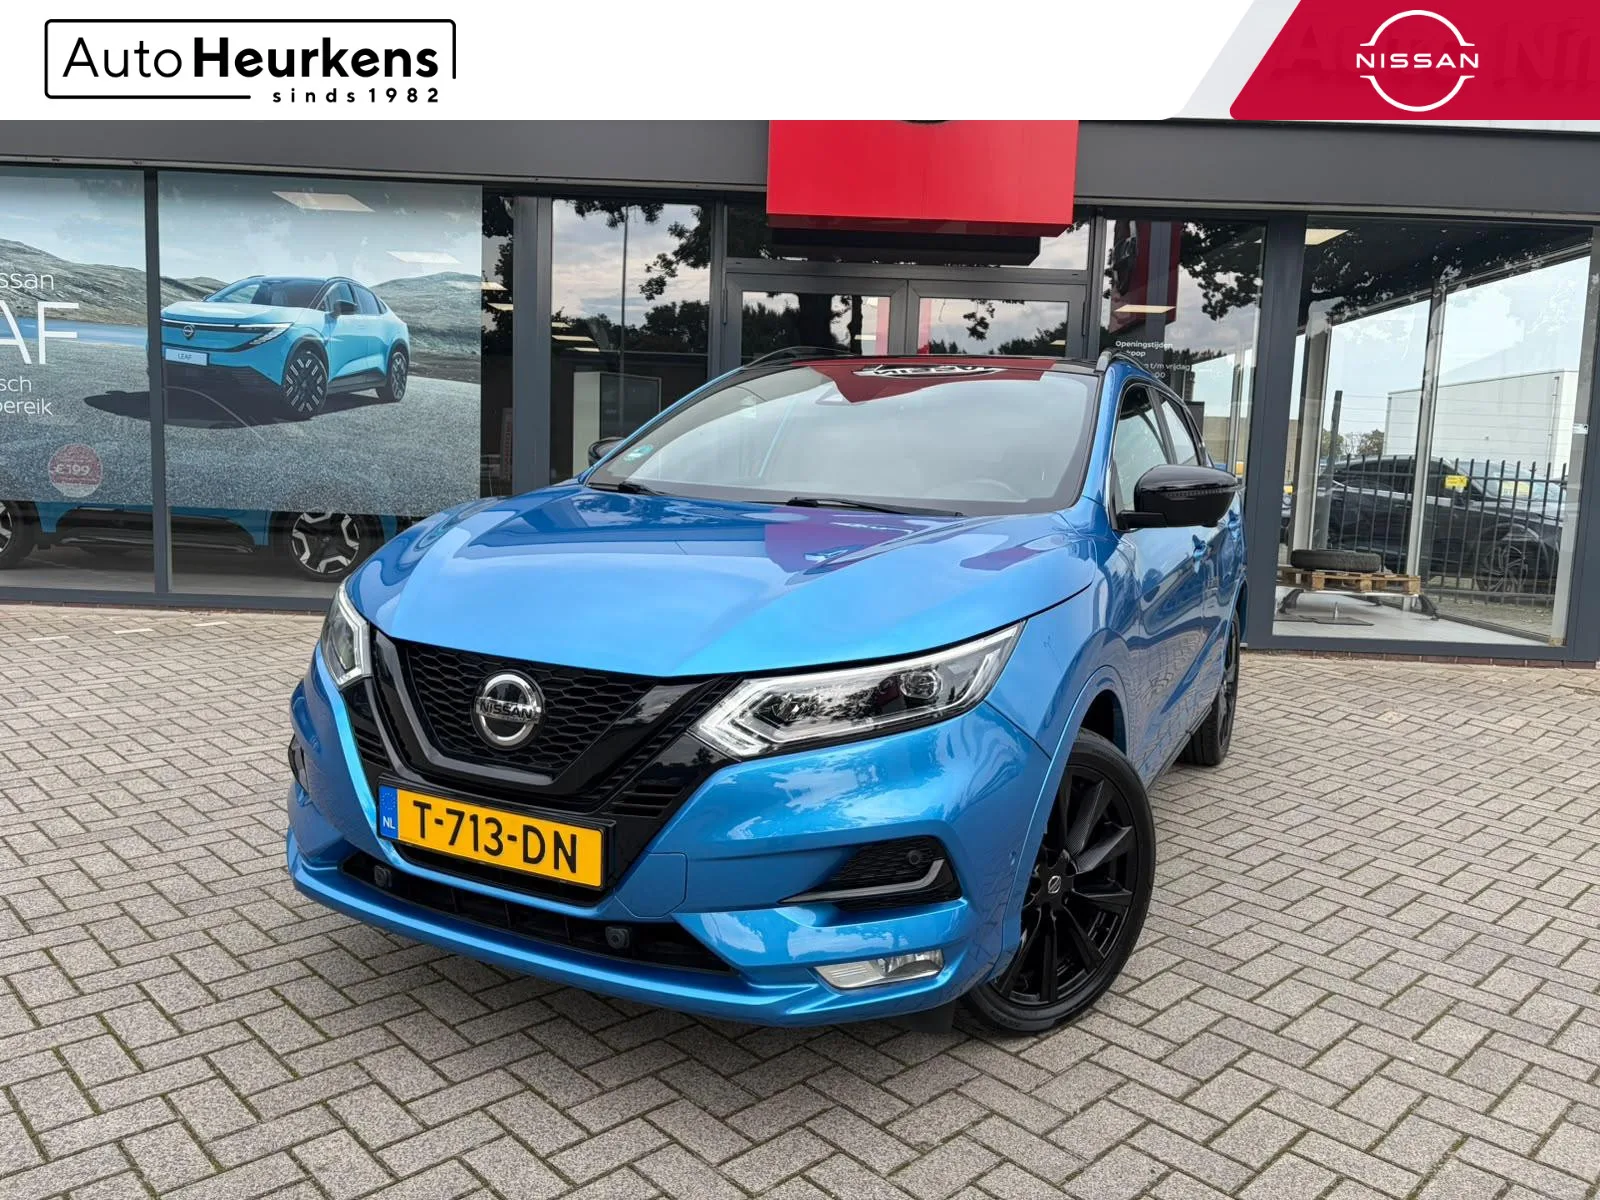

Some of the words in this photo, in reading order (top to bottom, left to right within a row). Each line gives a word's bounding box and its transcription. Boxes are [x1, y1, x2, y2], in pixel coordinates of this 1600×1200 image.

[1115, 341, 1173, 349] Openingstijden
[479, 700, 534, 720] NISSAN
[382, 815, 397, 830] NL
[412, 799, 578, 874] T-713-DN
